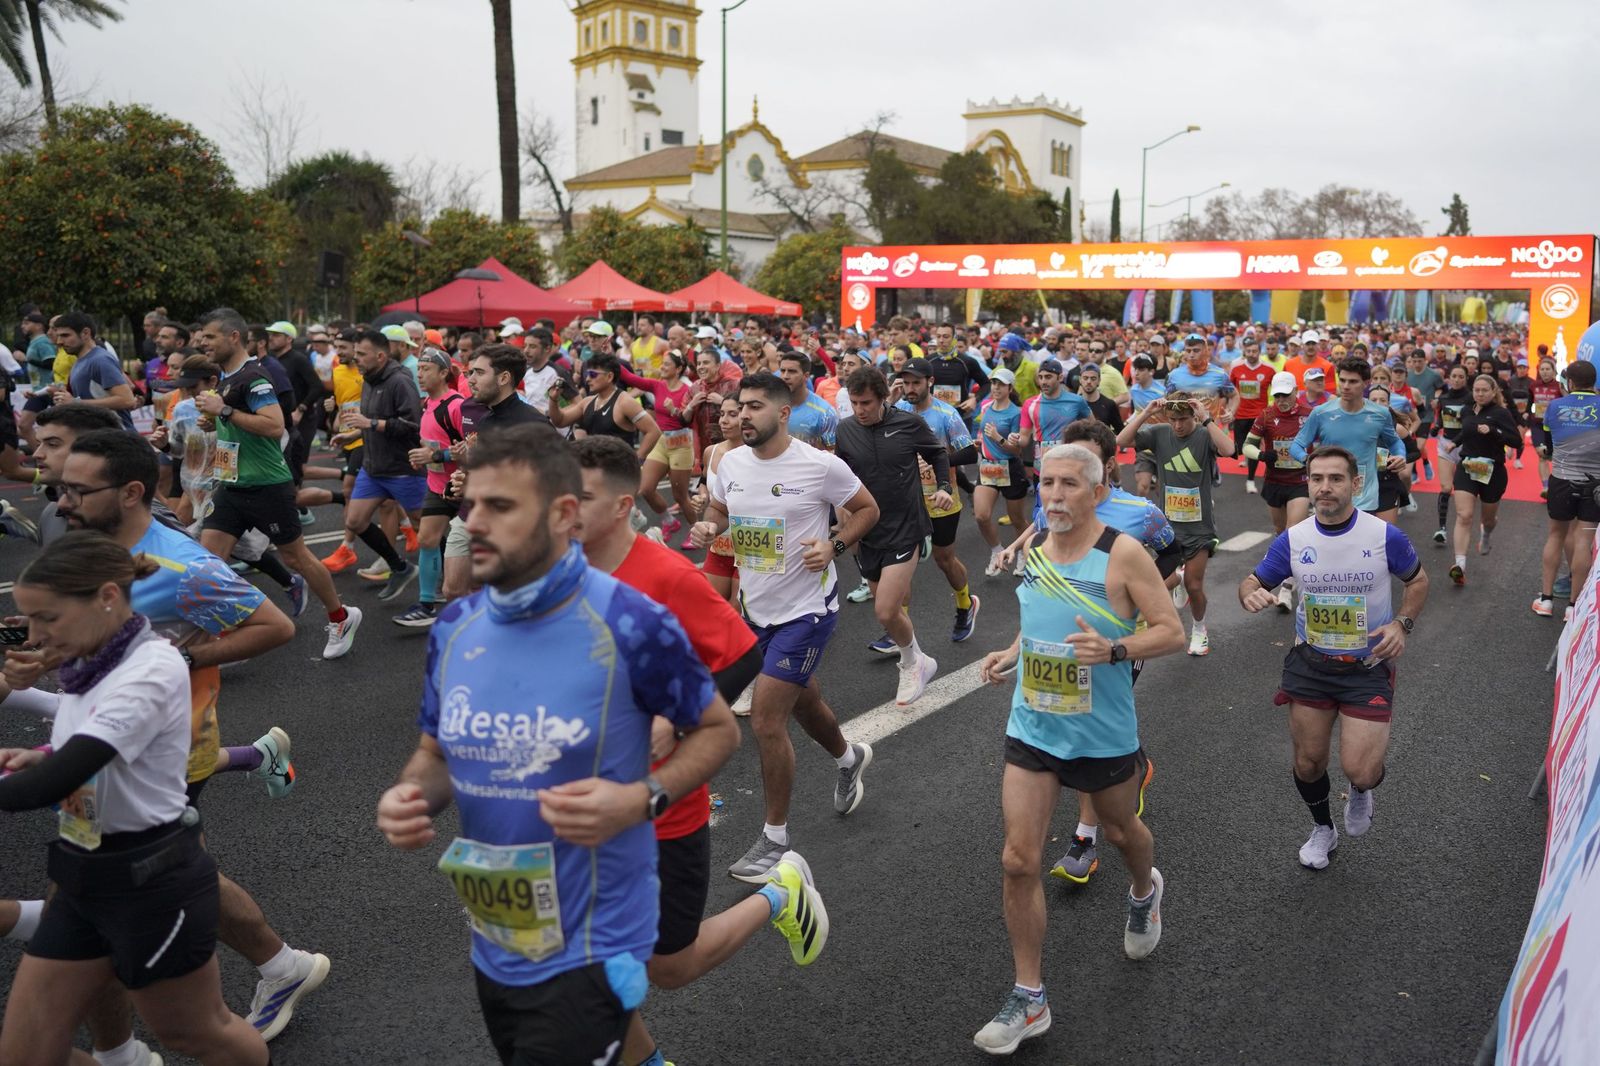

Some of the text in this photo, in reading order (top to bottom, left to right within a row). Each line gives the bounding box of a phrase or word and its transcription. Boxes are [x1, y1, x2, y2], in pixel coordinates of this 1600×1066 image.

[1246, 255, 1300, 273] HOKA
[1167, 495, 1196, 508] 17454
[737, 529, 770, 549] 9354
[1302, 571, 1374, 584] C.D. CALIFATO
[1312, 607, 1352, 626] 9314
[1024, 656, 1078, 684] 10216
